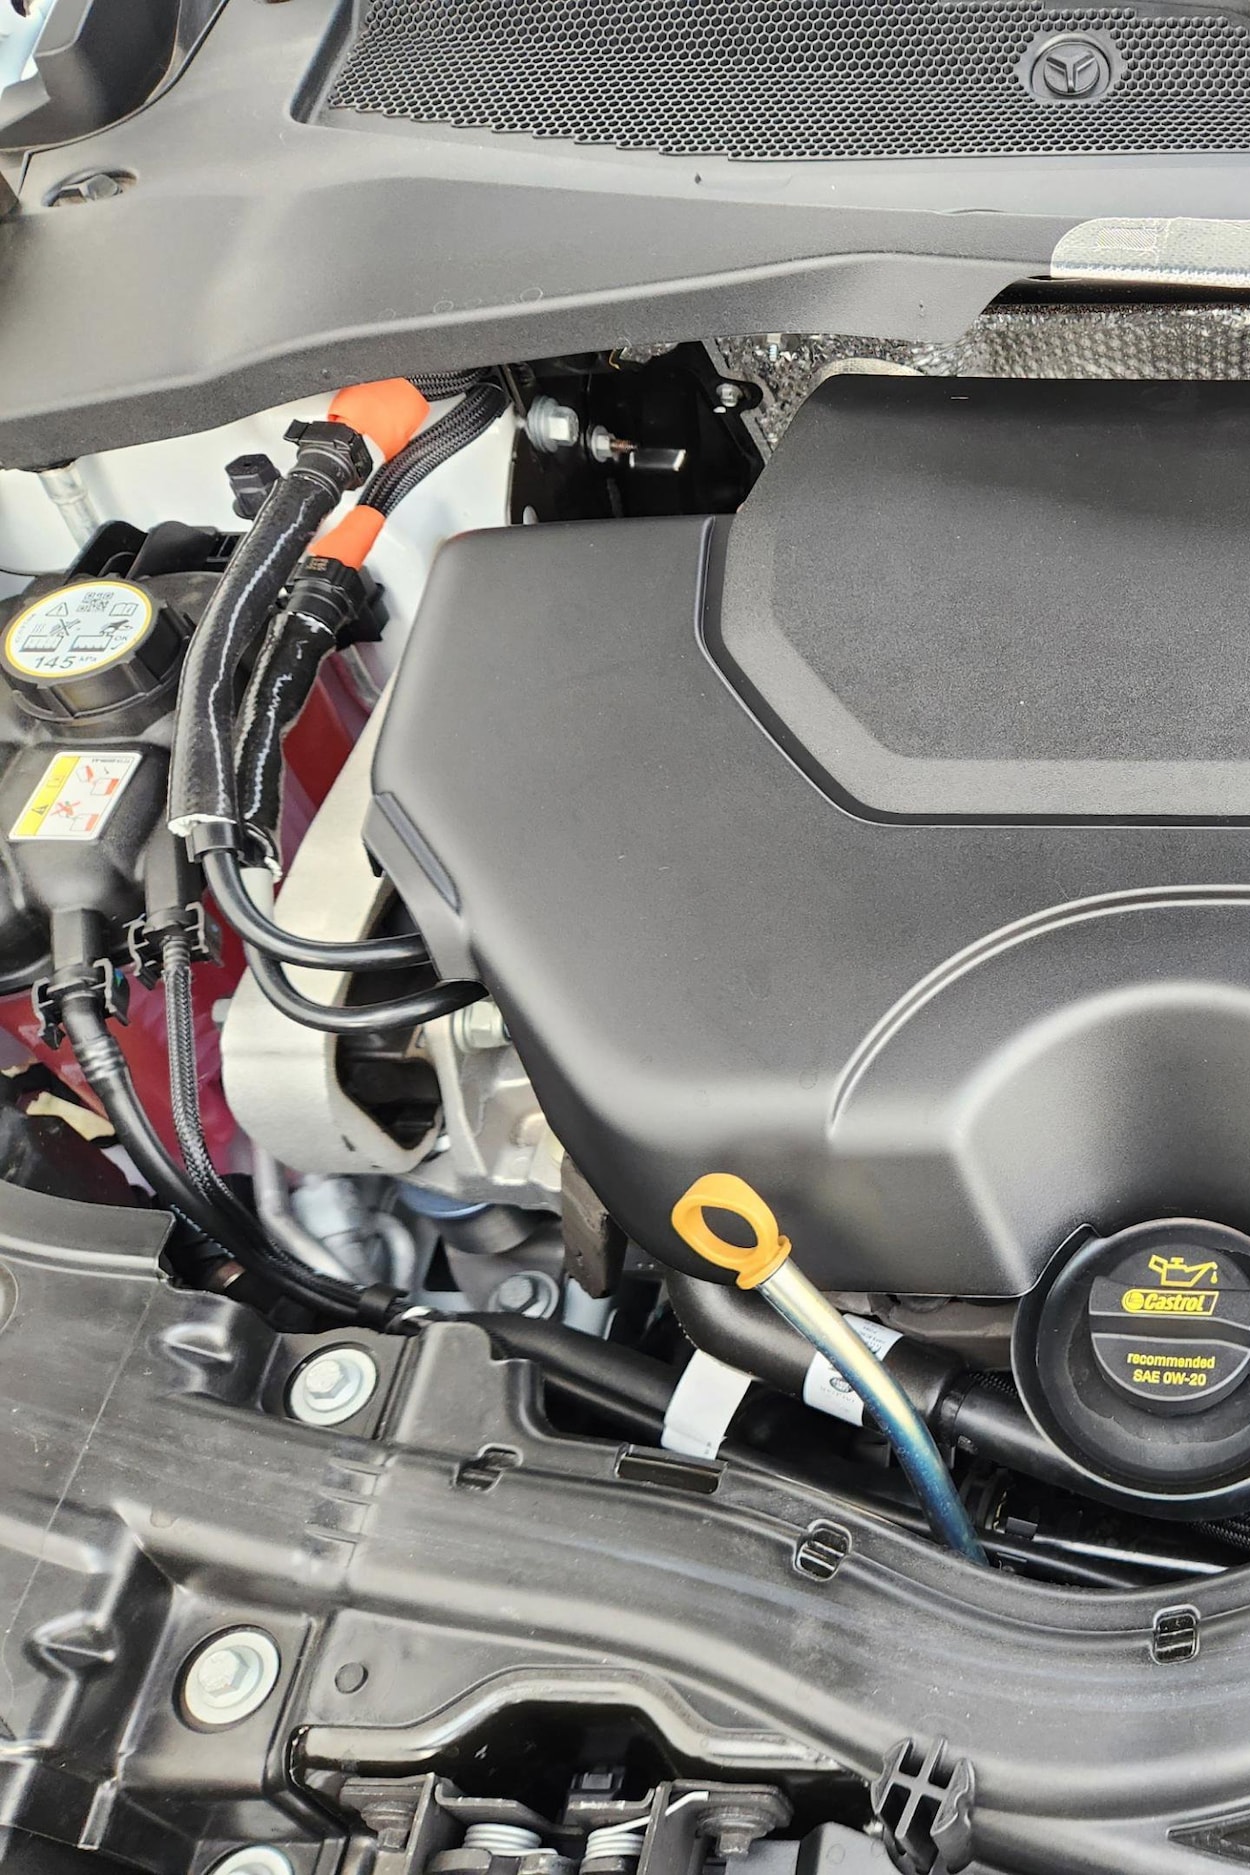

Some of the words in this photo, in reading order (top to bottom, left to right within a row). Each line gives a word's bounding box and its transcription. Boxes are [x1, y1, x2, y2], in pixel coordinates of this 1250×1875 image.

[34, 655, 78, 669] 145
[1142, 1292, 1205, 1312] Castrol
[1127, 1352, 1216, 1369] recommended
[1133, 1369, 1160, 1384] SAE
[1163, 1371, 1207, 1387] 0W-20
